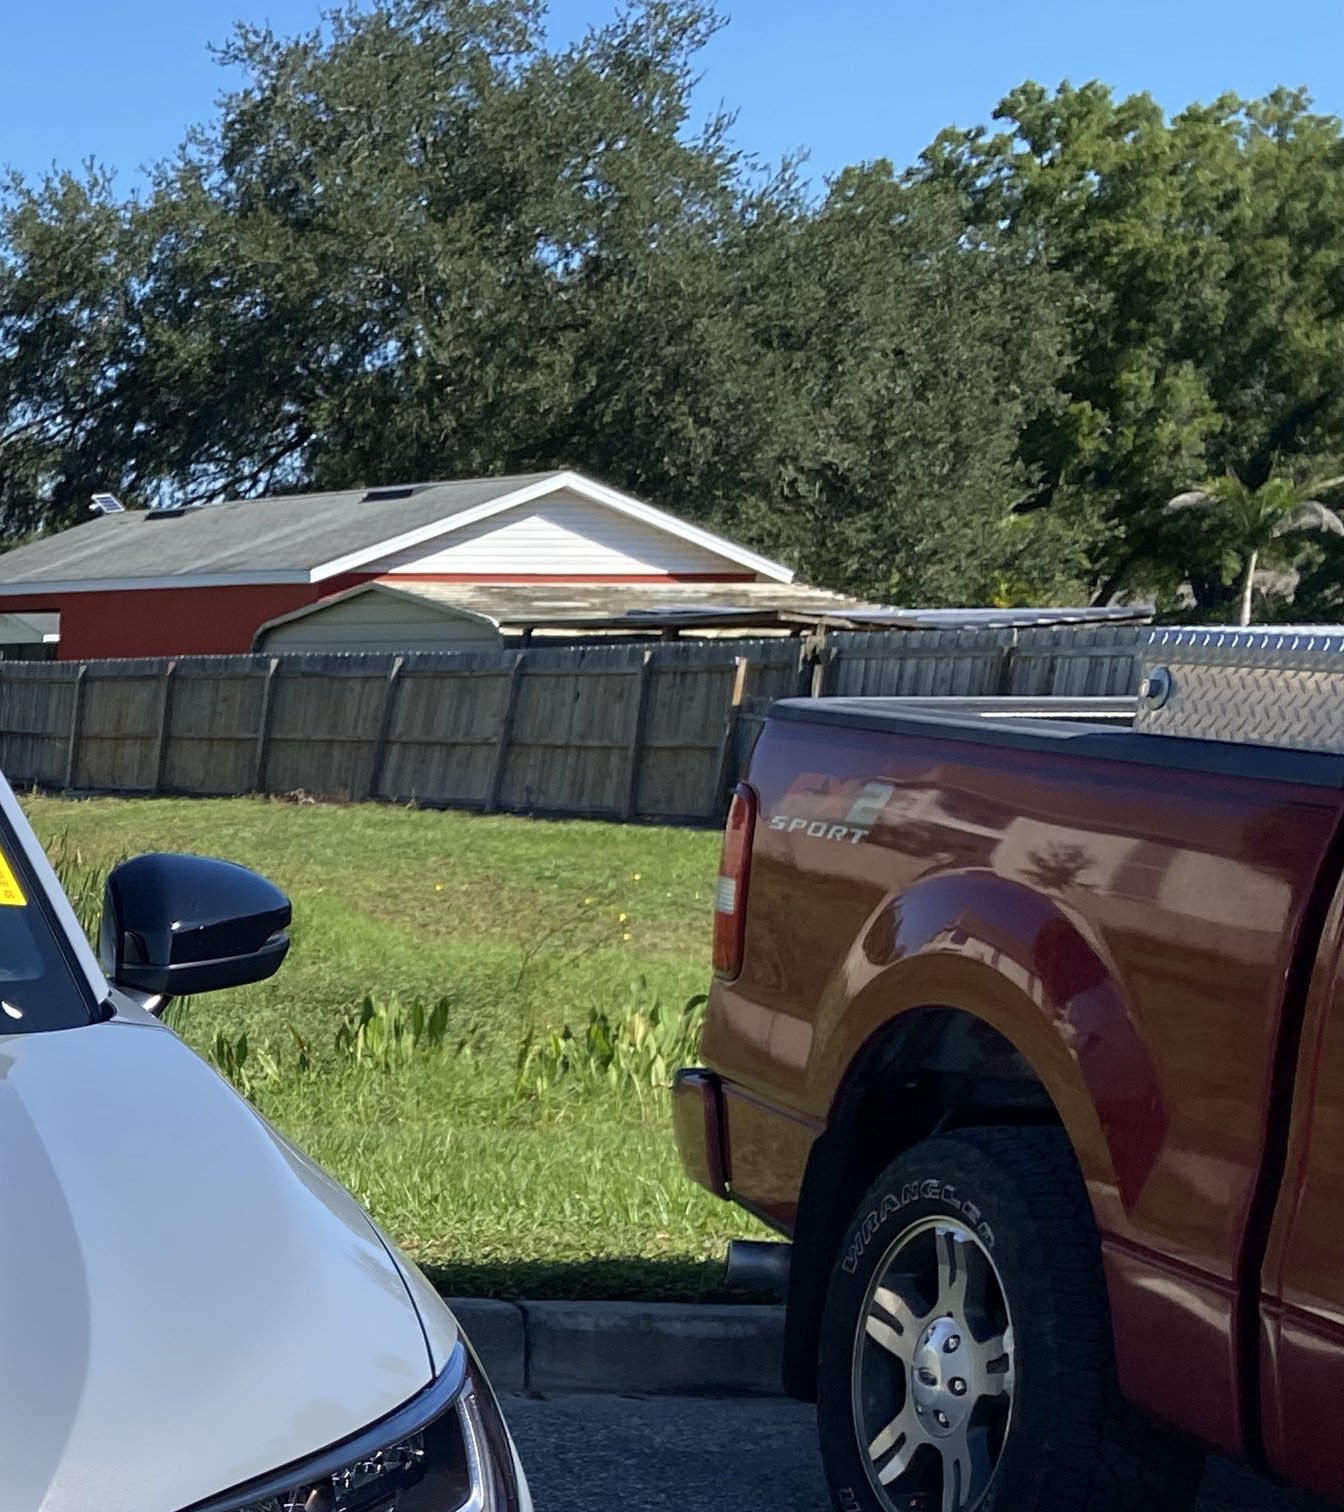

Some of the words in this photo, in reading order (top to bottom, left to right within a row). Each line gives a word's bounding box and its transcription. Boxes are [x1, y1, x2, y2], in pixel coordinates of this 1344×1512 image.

[769, 815, 869, 844] SPORT
[3, 890, 15, 899] IS
[842, 1178, 996, 1274] WRANGLER
